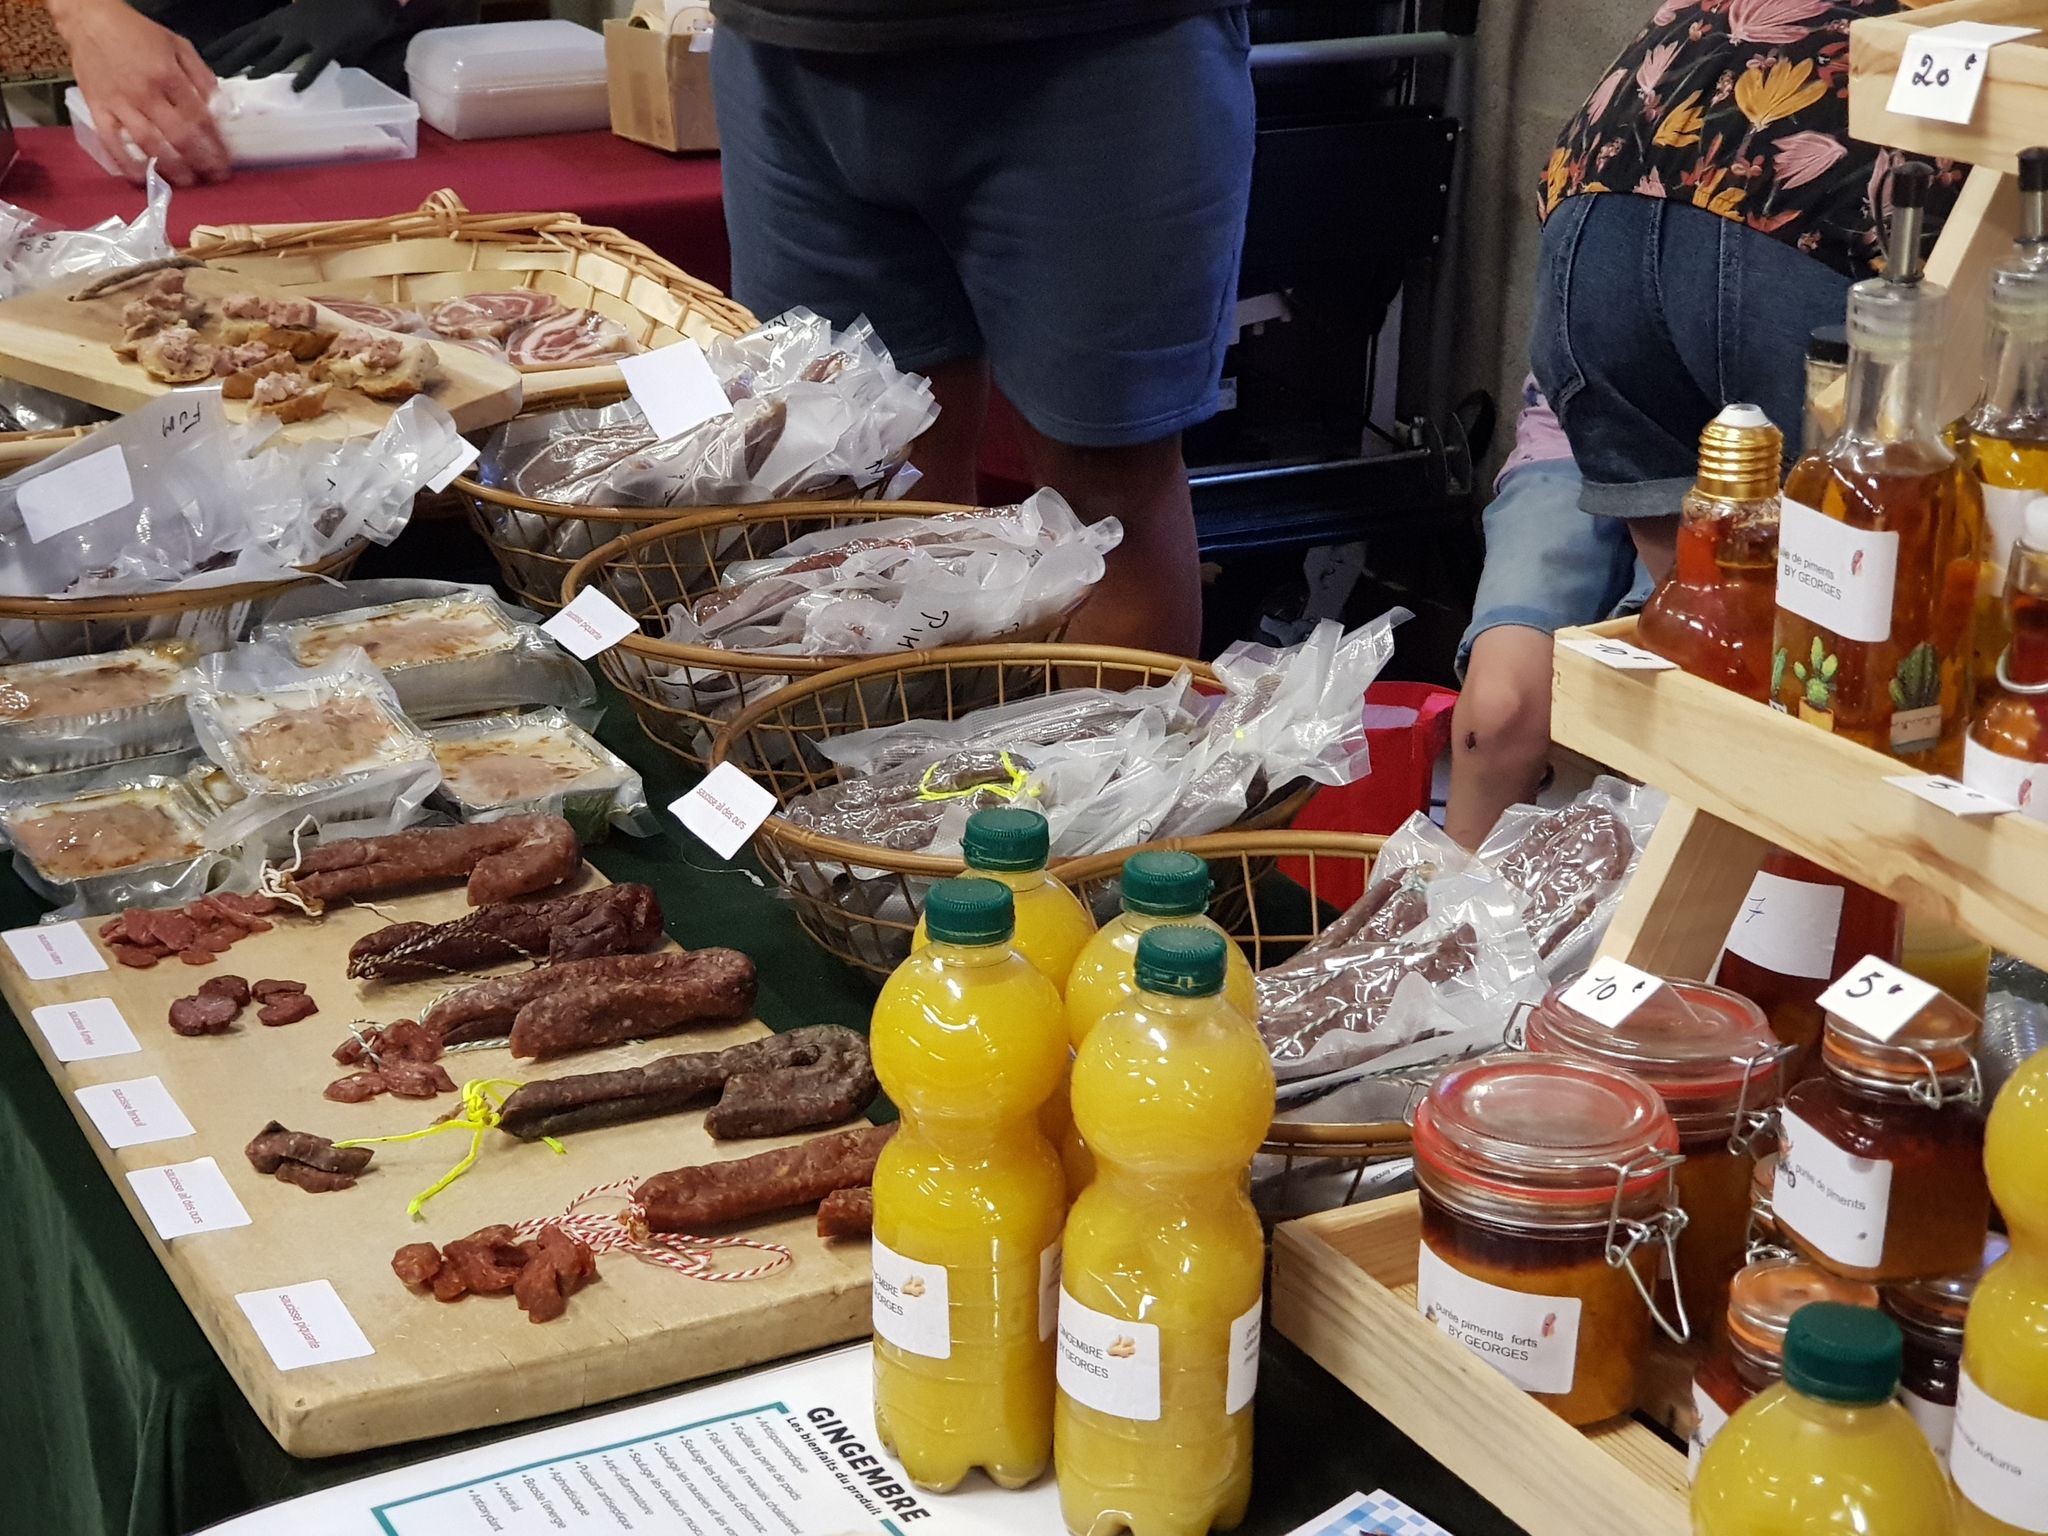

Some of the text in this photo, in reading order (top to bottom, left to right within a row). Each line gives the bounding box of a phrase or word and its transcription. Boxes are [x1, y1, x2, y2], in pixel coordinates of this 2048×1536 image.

[1784, 564, 1842, 600] BY GEORGES
[1792, 553, 1802, 565] de
[1804, 560, 1835, 580] piments
[696, 788, 718, 806] saucisse
[722, 807, 734, 820] des
[732, 816, 746, 830] ours
[67, 1009, 86, 1031] saucisse
[112, 1088, 133, 1110] saucisse
[163, 1168, 204, 1224] saucisse ail des ours
[1826, 1187, 1866, 1211] piments
[278, 1294, 320, 1349] saucisse piquante
[1461, 1319, 1504, 1342] piments
[1511, 1334, 1538, 1348] forts
[1448, 1324, 1529, 1361] BY GEORGES
[1066, 1348, 1109, 1379] GEORGES
[680, 1439, 708, 1466] Soulage
[702, 1464, 716, 1476] les
[751, 1447, 762, 1456] la
[754, 1456, 777, 1473] perte
[757, 1418, 808, 1474] Antispasmodique
[735, 1465, 747, 1475] le
[742, 1474, 770, 1502] mauvais
[772, 1473, 786, 1483] de
[786, 1416, 882, 1516] Les bienfaits du produit
[807, 1407, 931, 1523] GINGEMBRE
[496, 1484, 523, 1512] Antiviral
[523, 1478, 546, 1502] Booste
[550, 1472, 590, 1516] Aphrodisiaque
[576, 1463, 634, 1530] Puissant antiseptique
[629, 1452, 655, 1479] Soulage
[650, 1478, 664, 1490] les
[658, 1488, 687, 1517] douleurs
[655, 1444, 681, 1472] Soulage
[676, 1471, 690, 1483] les
[706, 1508, 720, 1517] et
[714, 1515, 728, 1526] les
[778, 1482, 802, 1501] poids
[469, 1494, 504, 1532] Antioxydant
